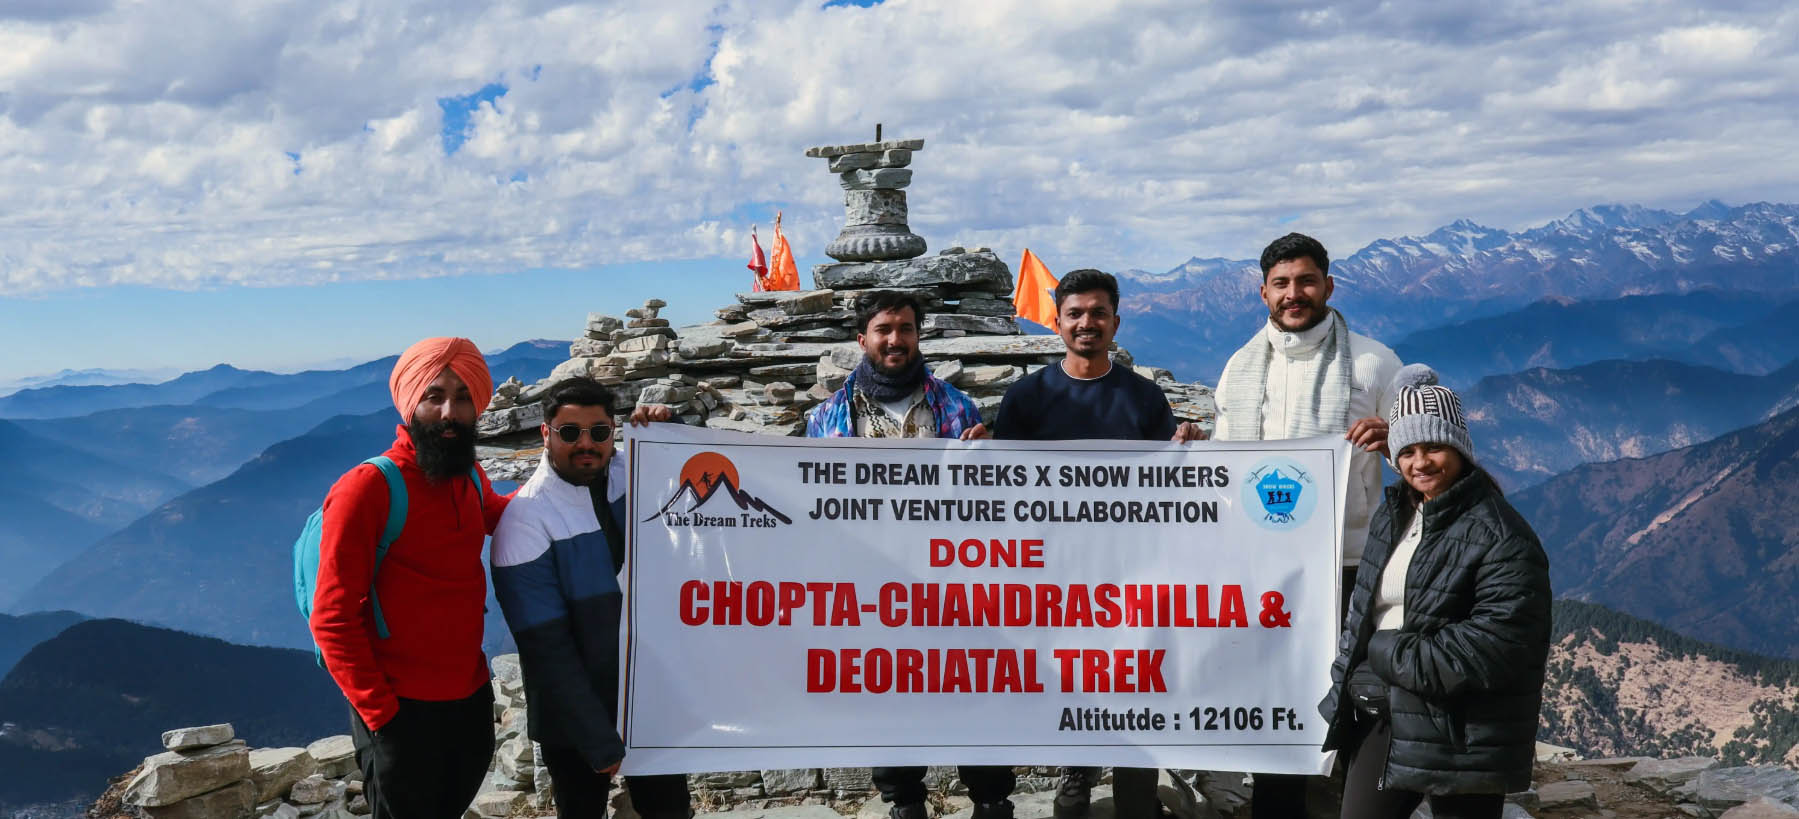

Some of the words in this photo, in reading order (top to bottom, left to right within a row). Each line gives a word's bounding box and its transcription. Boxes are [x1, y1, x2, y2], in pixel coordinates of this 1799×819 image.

[798, 462, 847, 485] THE
[855, 463, 940, 486] DREAM
[947, 464, 1028, 487] TREKS
[1034, 465, 1052, 487] X
[1058, 465, 1131, 488] SNOW
[1138, 465, 1230, 488] HIKERS
[665, 512, 690, 527] The
[693, 512, 737, 528] Dream
[740, 513, 777, 529] Treks
[808, 498, 884, 521] JOINT
[890, 499, 1006, 522] VENTURE
[1013, 500, 1218, 523] COLLABORATION
[929, 538, 1045, 568] DONE
[679, 580, 1249, 628] CHOPTA-CHANDRASHILLA
[1258, 590, 1292, 628] &
[807, 648, 1044, 694] DEORIATAL
[1053, 648, 1167, 693] TREK
[1058, 707, 1166, 731] Altitutde
[1173, 713, 1181, 731] :
[1189, 706, 1264, 731] 12106
[1271, 707, 1304, 731] Ft.
